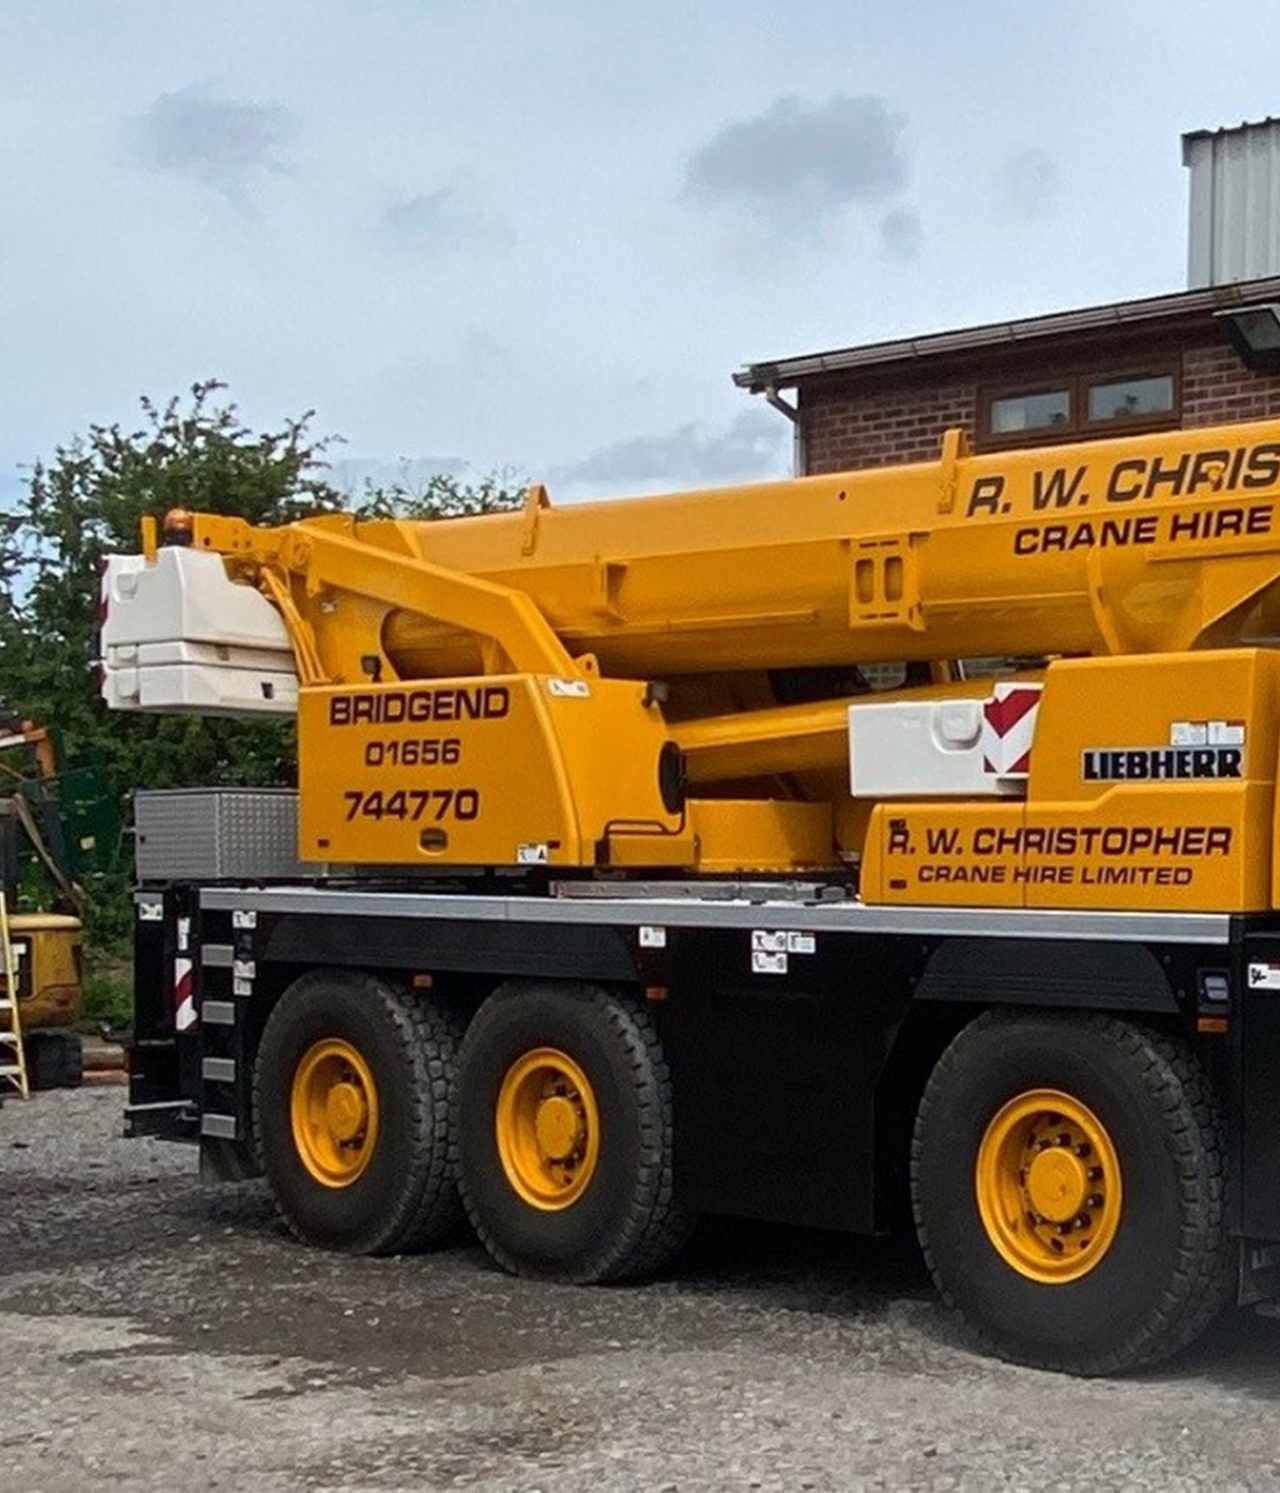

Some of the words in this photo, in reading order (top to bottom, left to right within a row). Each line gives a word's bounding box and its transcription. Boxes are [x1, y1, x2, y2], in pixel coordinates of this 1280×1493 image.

[966, 476, 1012, 517] R.
[1032, 465, 1090, 511] W.
[1013, 515, 1158, 555] CRANE
[1169, 504, 1274, 541] HIRE
[329, 687, 510, 726] BRIDGEND
[364, 738, 461, 767] 01656
[1083, 750, 1242, 780] LIEBHERR
[343, 788, 479, 821] 744770
[887, 828, 916, 854] R.
[925, 828, 964, 855] W.
[972, 826, 1233, 856] CHRISTOPHER
[918, 865, 1006, 884] CRANE
[1013, 865, 1076, 884] HIRE
[1080, 867, 1193, 886] LIMITED
